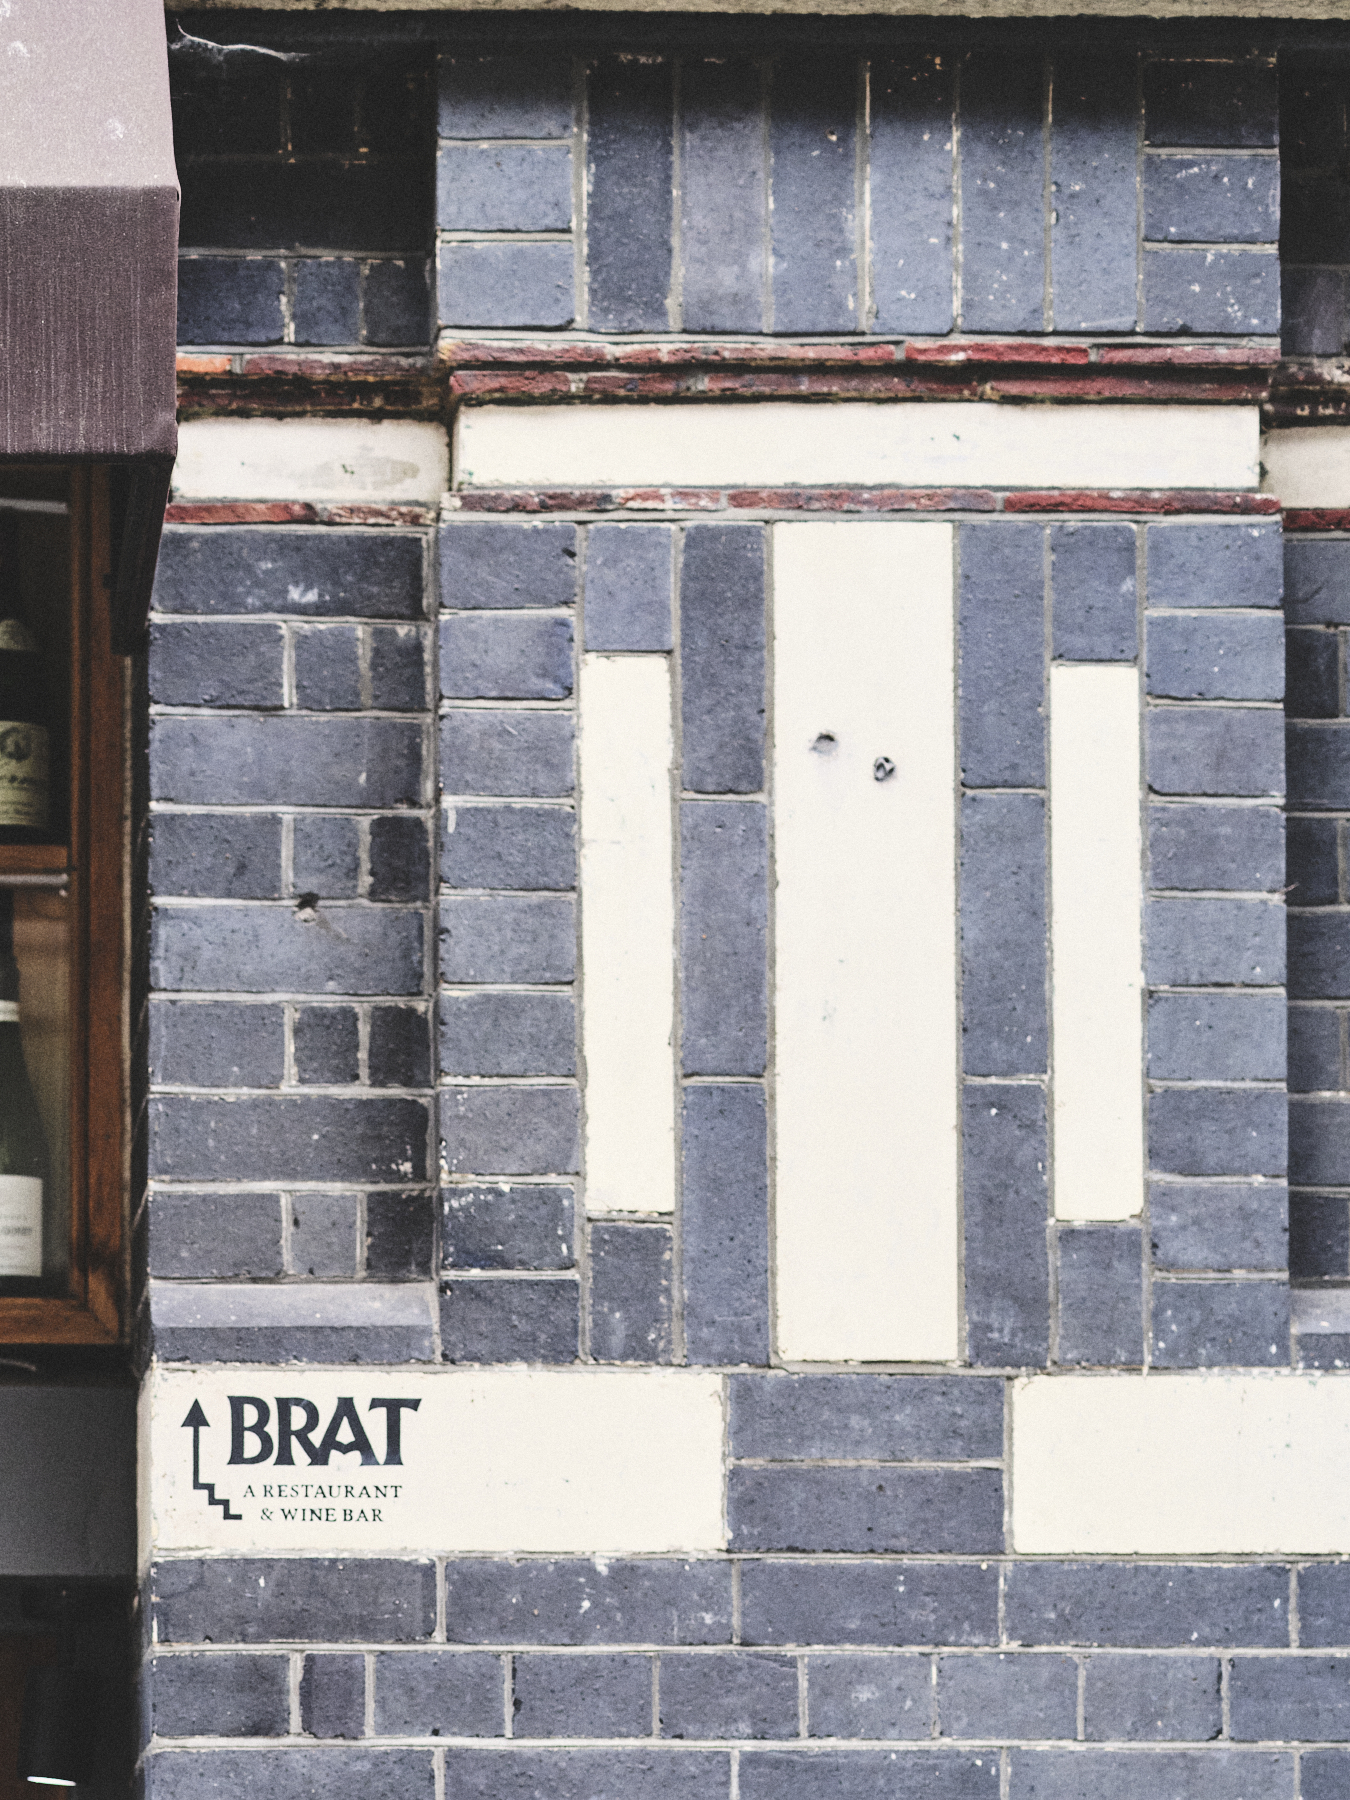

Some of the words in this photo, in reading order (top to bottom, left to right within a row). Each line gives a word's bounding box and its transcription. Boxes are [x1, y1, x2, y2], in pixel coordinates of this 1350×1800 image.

[227, 1396, 422, 1466] BRAT
[243, 1485, 256, 1498] A
[262, 1484, 403, 1498] RESTAURANT
[260, 1508, 274, 1521] &
[280, 1508, 337, 1522] WINE
[343, 1508, 383, 1522] BAR
